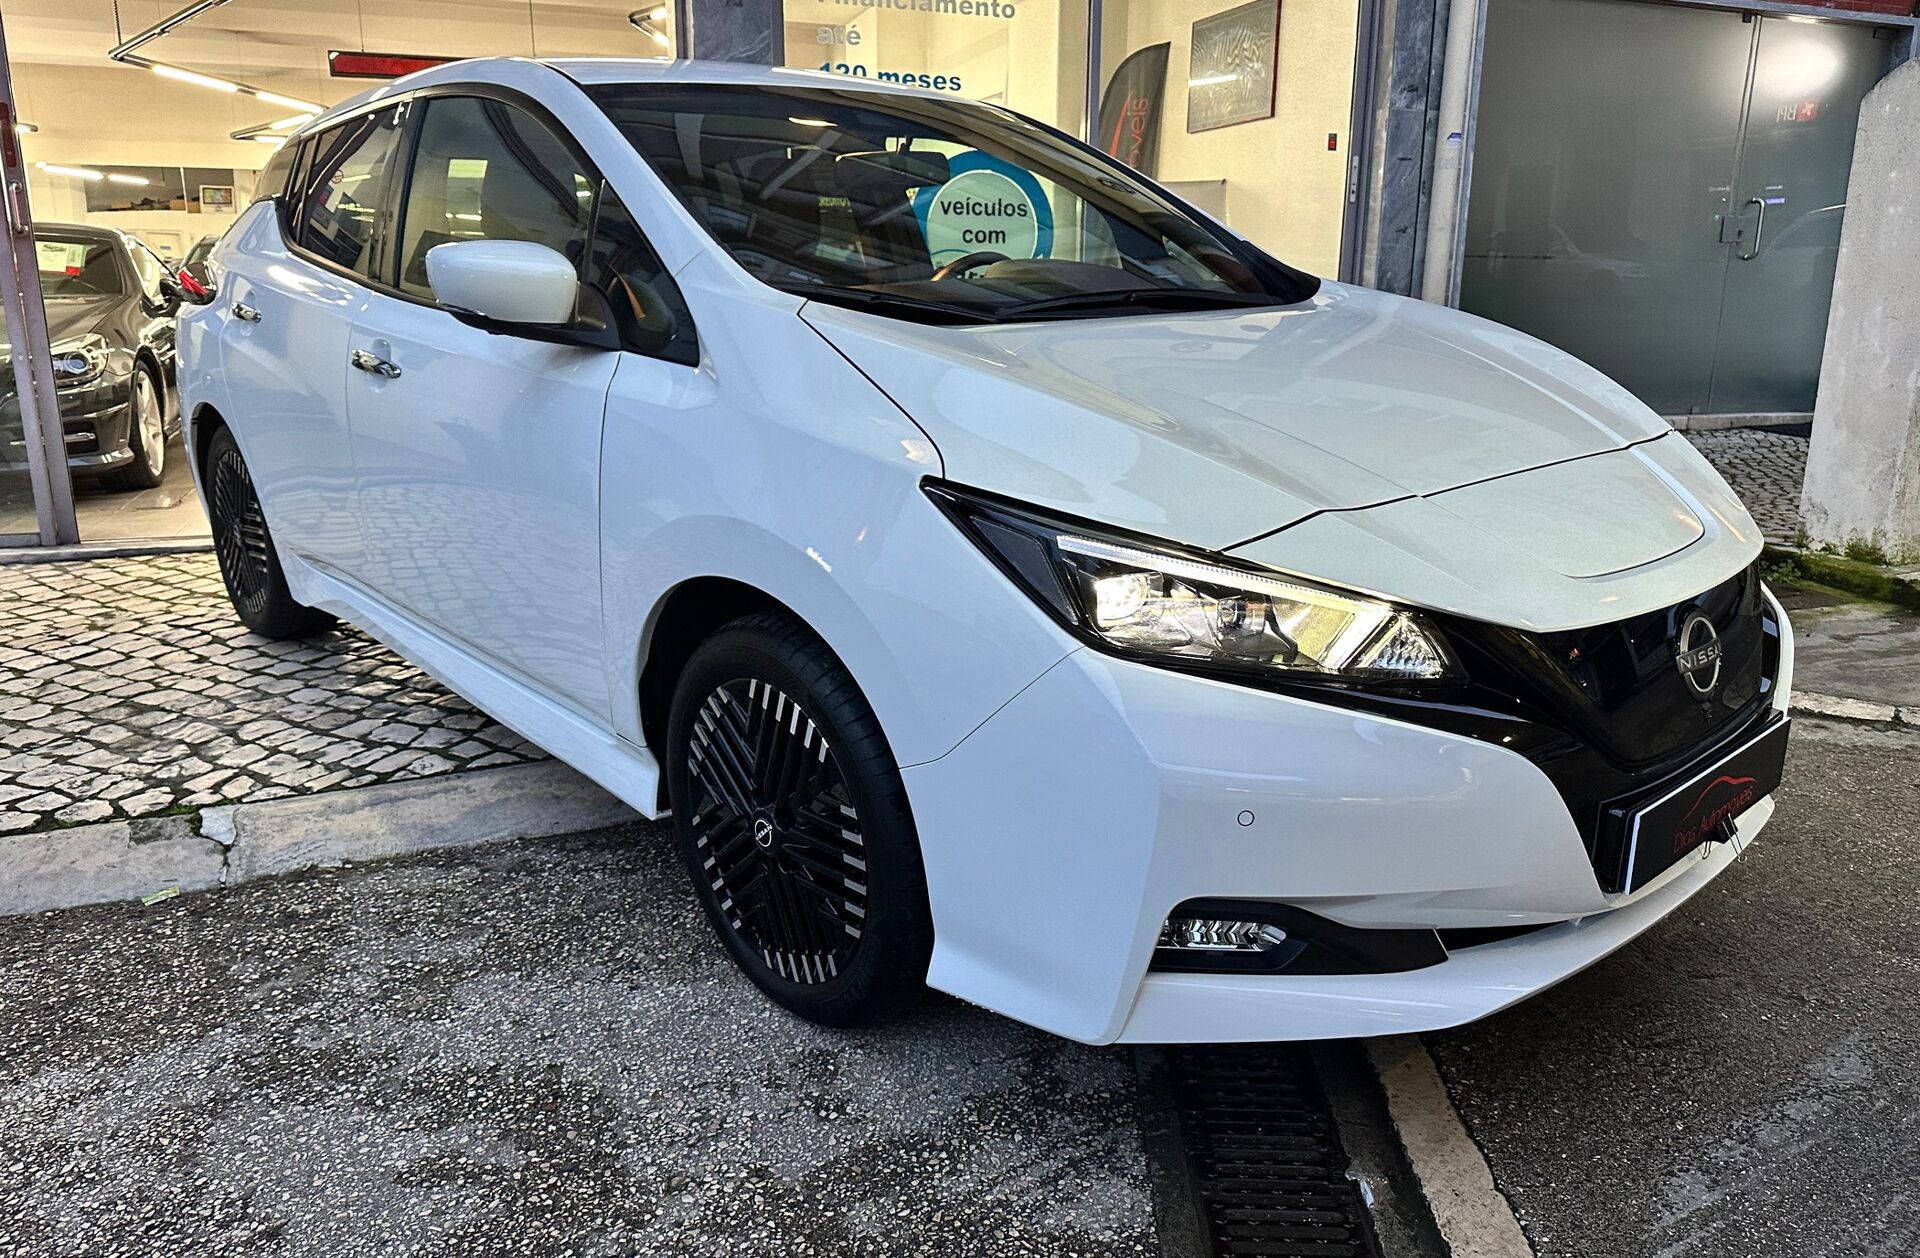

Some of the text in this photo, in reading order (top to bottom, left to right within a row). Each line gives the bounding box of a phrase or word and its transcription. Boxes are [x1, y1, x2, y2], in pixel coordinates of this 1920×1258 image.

[818, 0, 1016, 19] nciamento
[816, 25, 862, 46] até
[878, 71, 962, 91] meses
[940, 197, 1028, 217] veículos
[962, 229, 1006, 244] com
